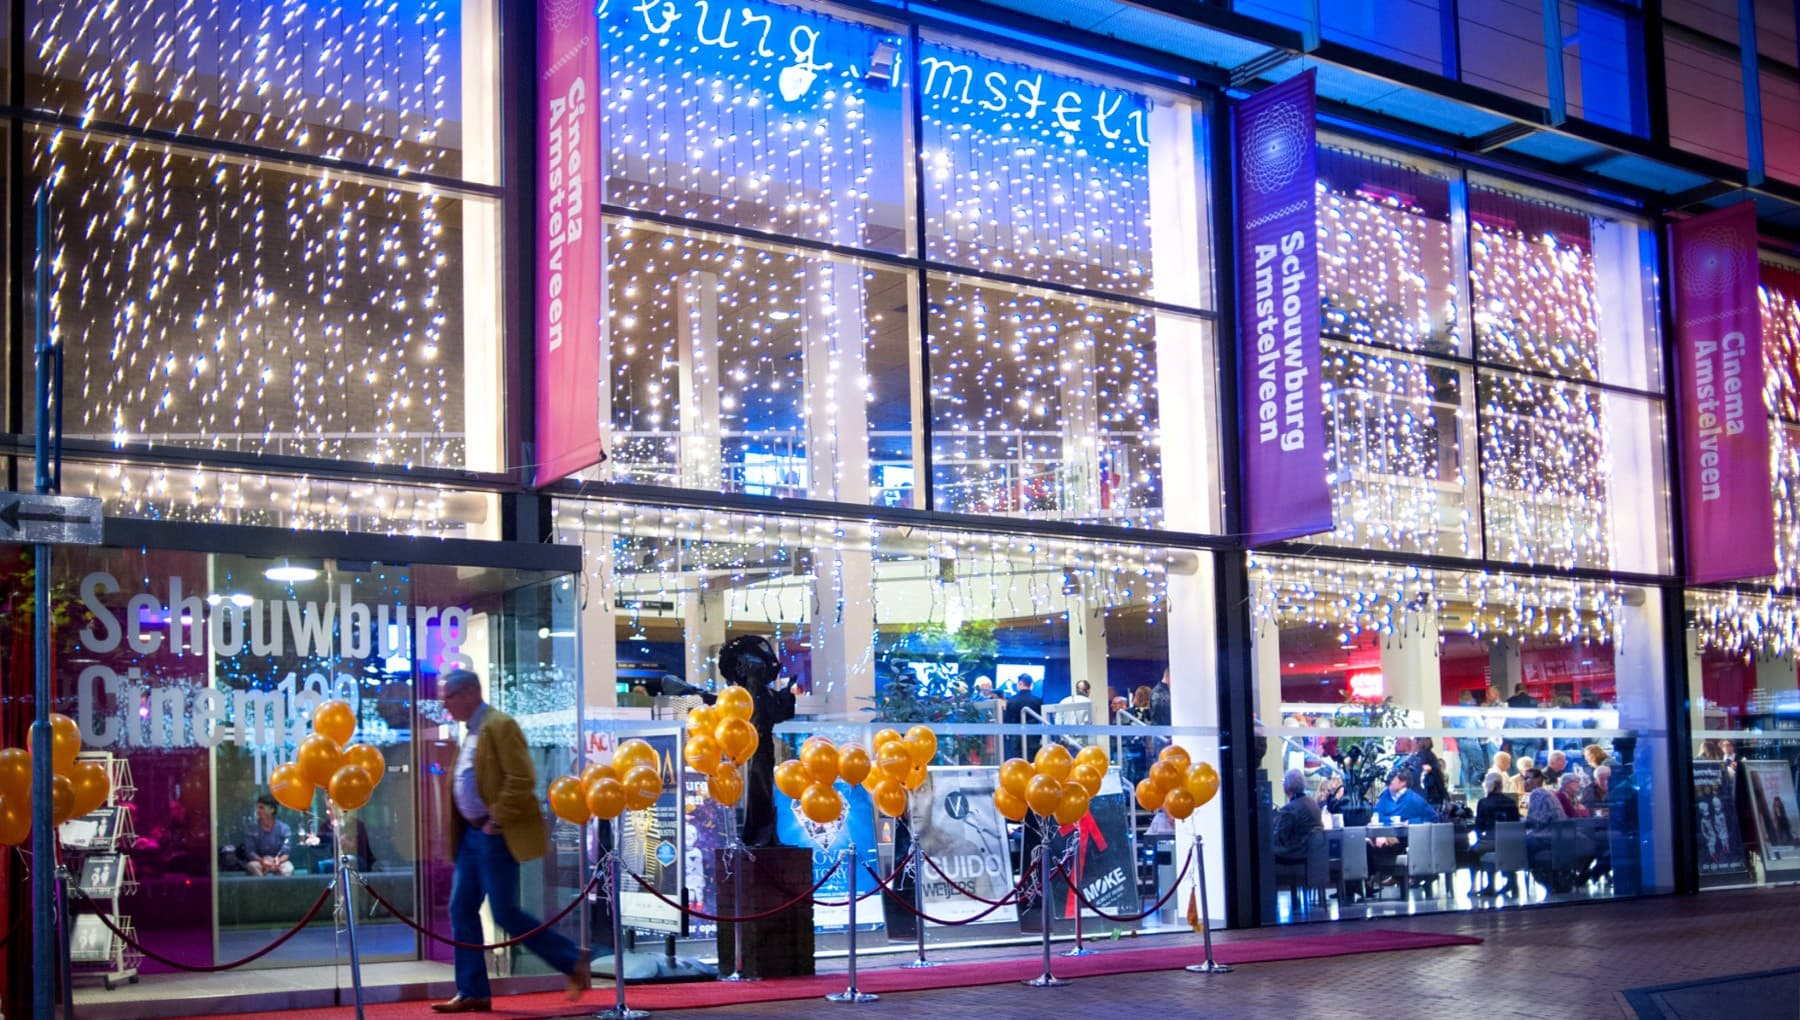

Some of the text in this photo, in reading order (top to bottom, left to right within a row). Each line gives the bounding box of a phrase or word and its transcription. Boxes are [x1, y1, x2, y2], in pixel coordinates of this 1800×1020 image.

[597, 0, 834, 72] burg
[548, 96, 566, 352] Amstelveen
[567, 76, 585, 244] Cinema
[1255, 243, 1281, 443] Amstelveen
[1281, 230, 1309, 452] Schouwburg
[1694, 340, 1720, 502] Amstelveen
[1721, 331, 1745, 436] Cinema
[79, 571, 473, 676] Schouwburg
[922, 853, 1002, 881] GUIDO
